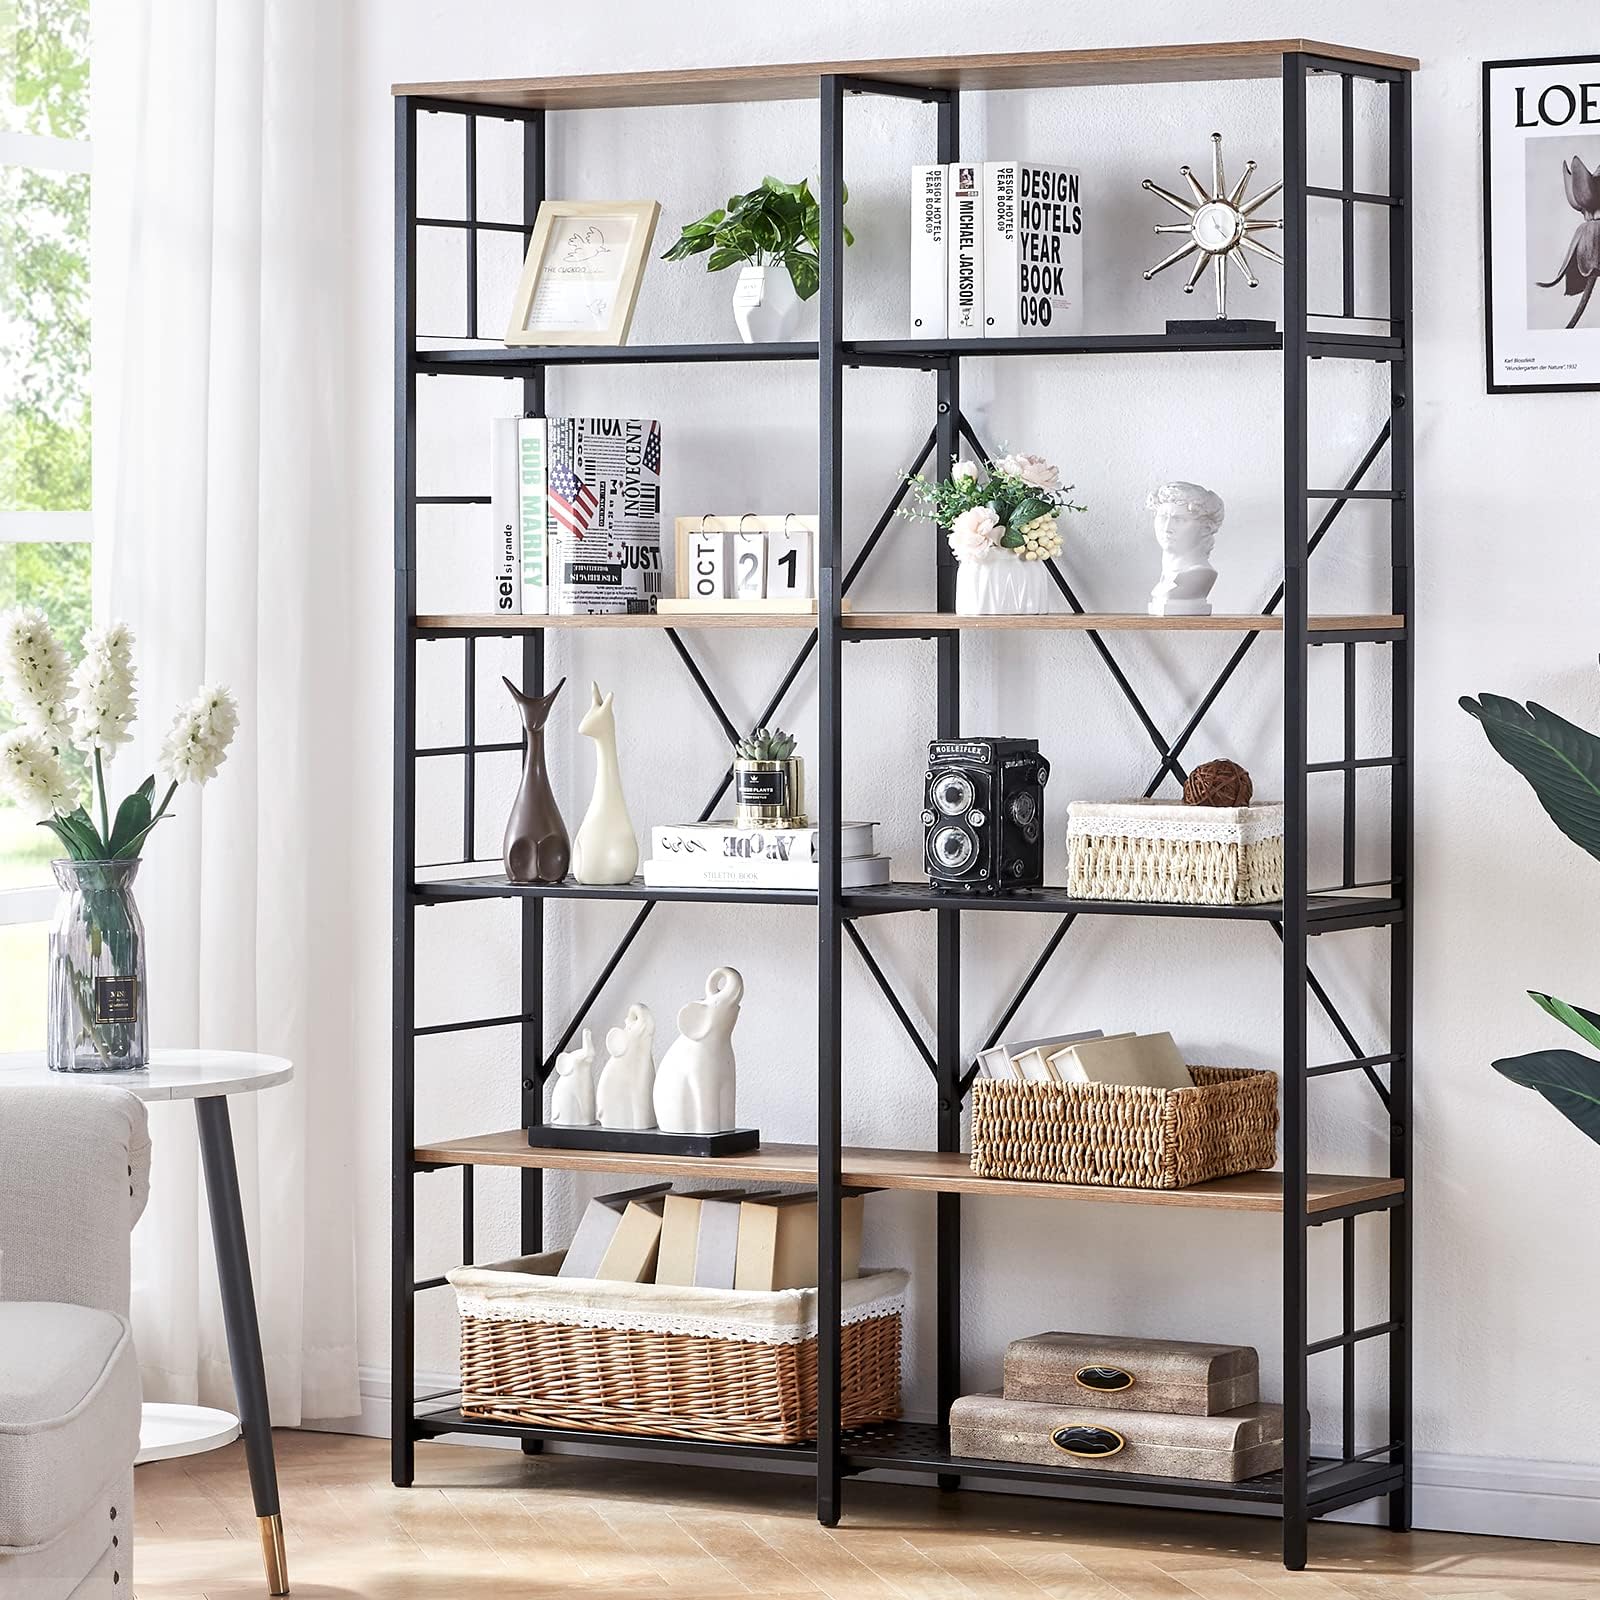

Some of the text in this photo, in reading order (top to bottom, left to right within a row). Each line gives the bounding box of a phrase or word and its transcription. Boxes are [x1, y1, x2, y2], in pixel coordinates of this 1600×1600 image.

[925, 170, 934, 194] YEAR
[997, 168, 1006, 192] YEAR
[1021, 168, 1079, 203] DESIGN
[933, 170, 942, 242] DESIGN HOTELS
[1005, 168, 1014, 240] DESIGN HOTELS
[1020, 200, 1082, 235] HOTELS
[959, 200, 974, 250] MICHAEL
[1020, 232, 1061, 264] YEAR
[959, 254, 974, 306] JACKSON
[1020, 264, 1064, 296] BOOK
[521, 438, 544, 588] BOB MARLEY
[504, 524, 515, 561] grande
[621, 545, 660, 570] JUST
[696, 543, 715, 596] OCT
[496, 575, 513, 610] sei
[703, 872, 759, 880] STILETTO BOOK
